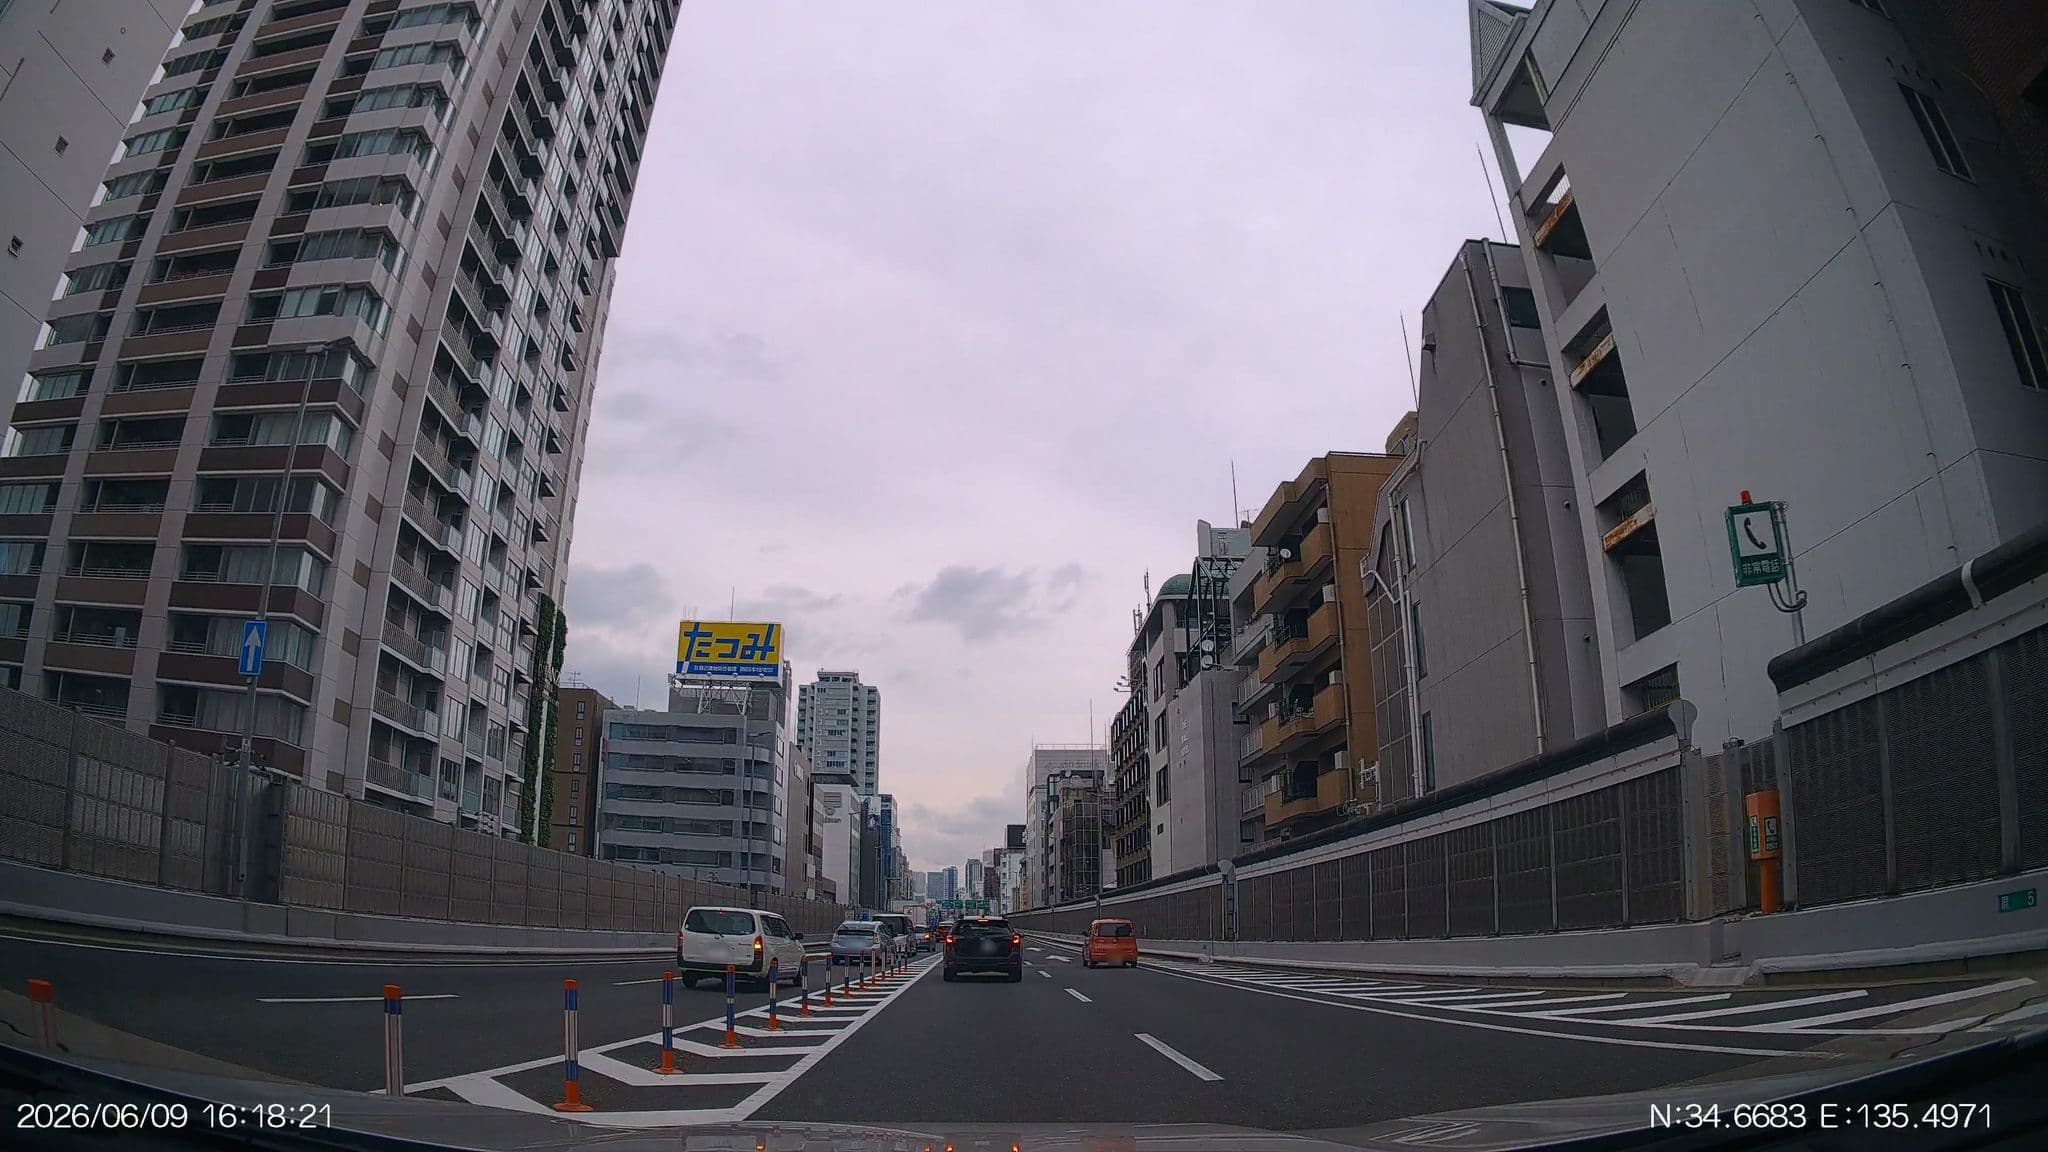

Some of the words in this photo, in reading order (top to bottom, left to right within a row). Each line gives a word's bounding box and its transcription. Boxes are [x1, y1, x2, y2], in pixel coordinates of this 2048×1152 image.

[1742, 558, 1780, 576] 非常電話
[682, 622, 775, 664] たつみ
